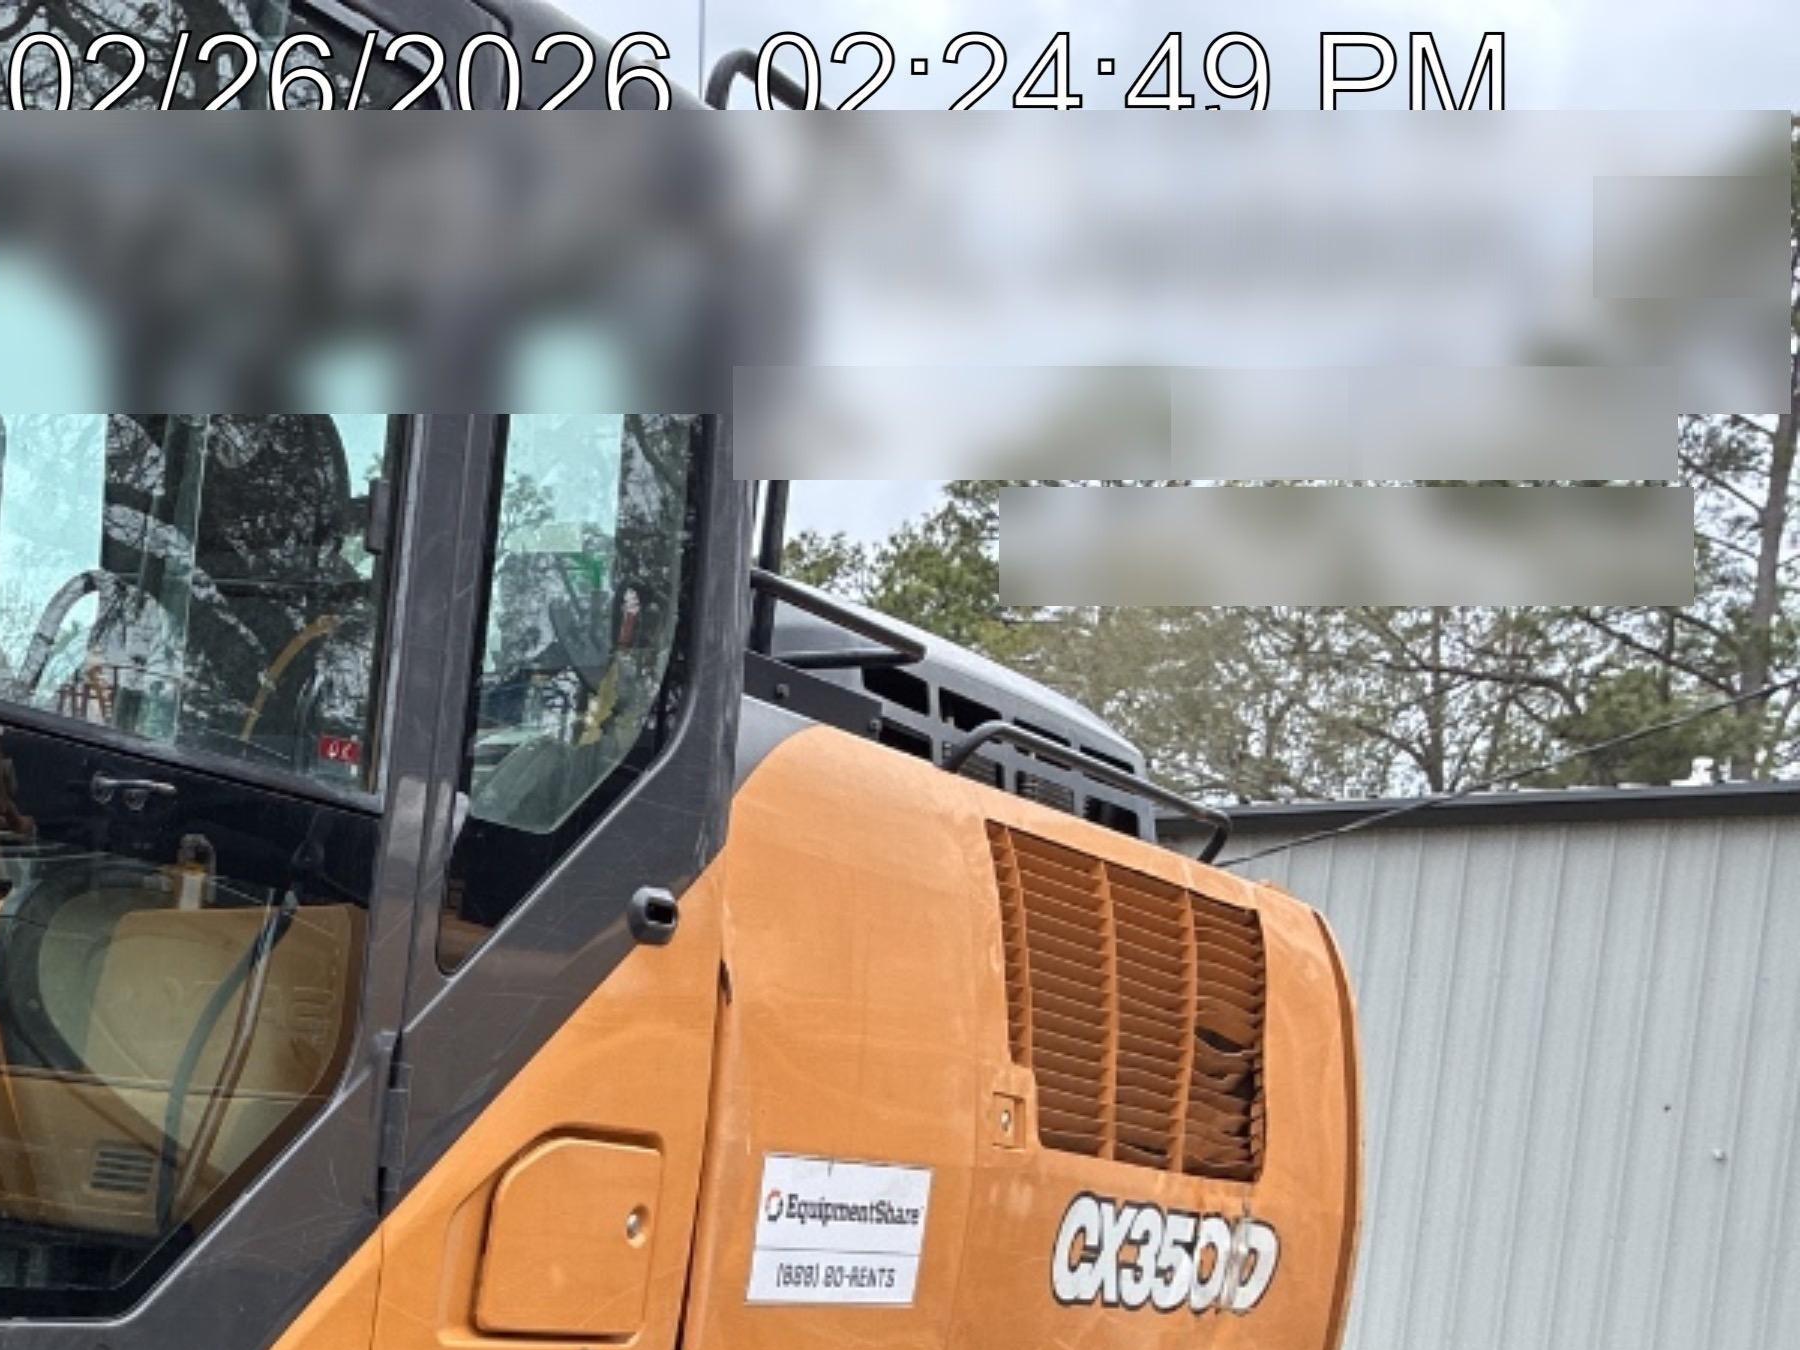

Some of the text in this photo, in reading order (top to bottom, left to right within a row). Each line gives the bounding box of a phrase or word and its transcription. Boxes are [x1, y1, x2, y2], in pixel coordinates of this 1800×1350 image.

[785, 1193, 920, 1228] EquipmentShare
[1052, 1190, 1282, 1316] CX350D
[775, 1263, 896, 1289] (888) 80-RENTS
